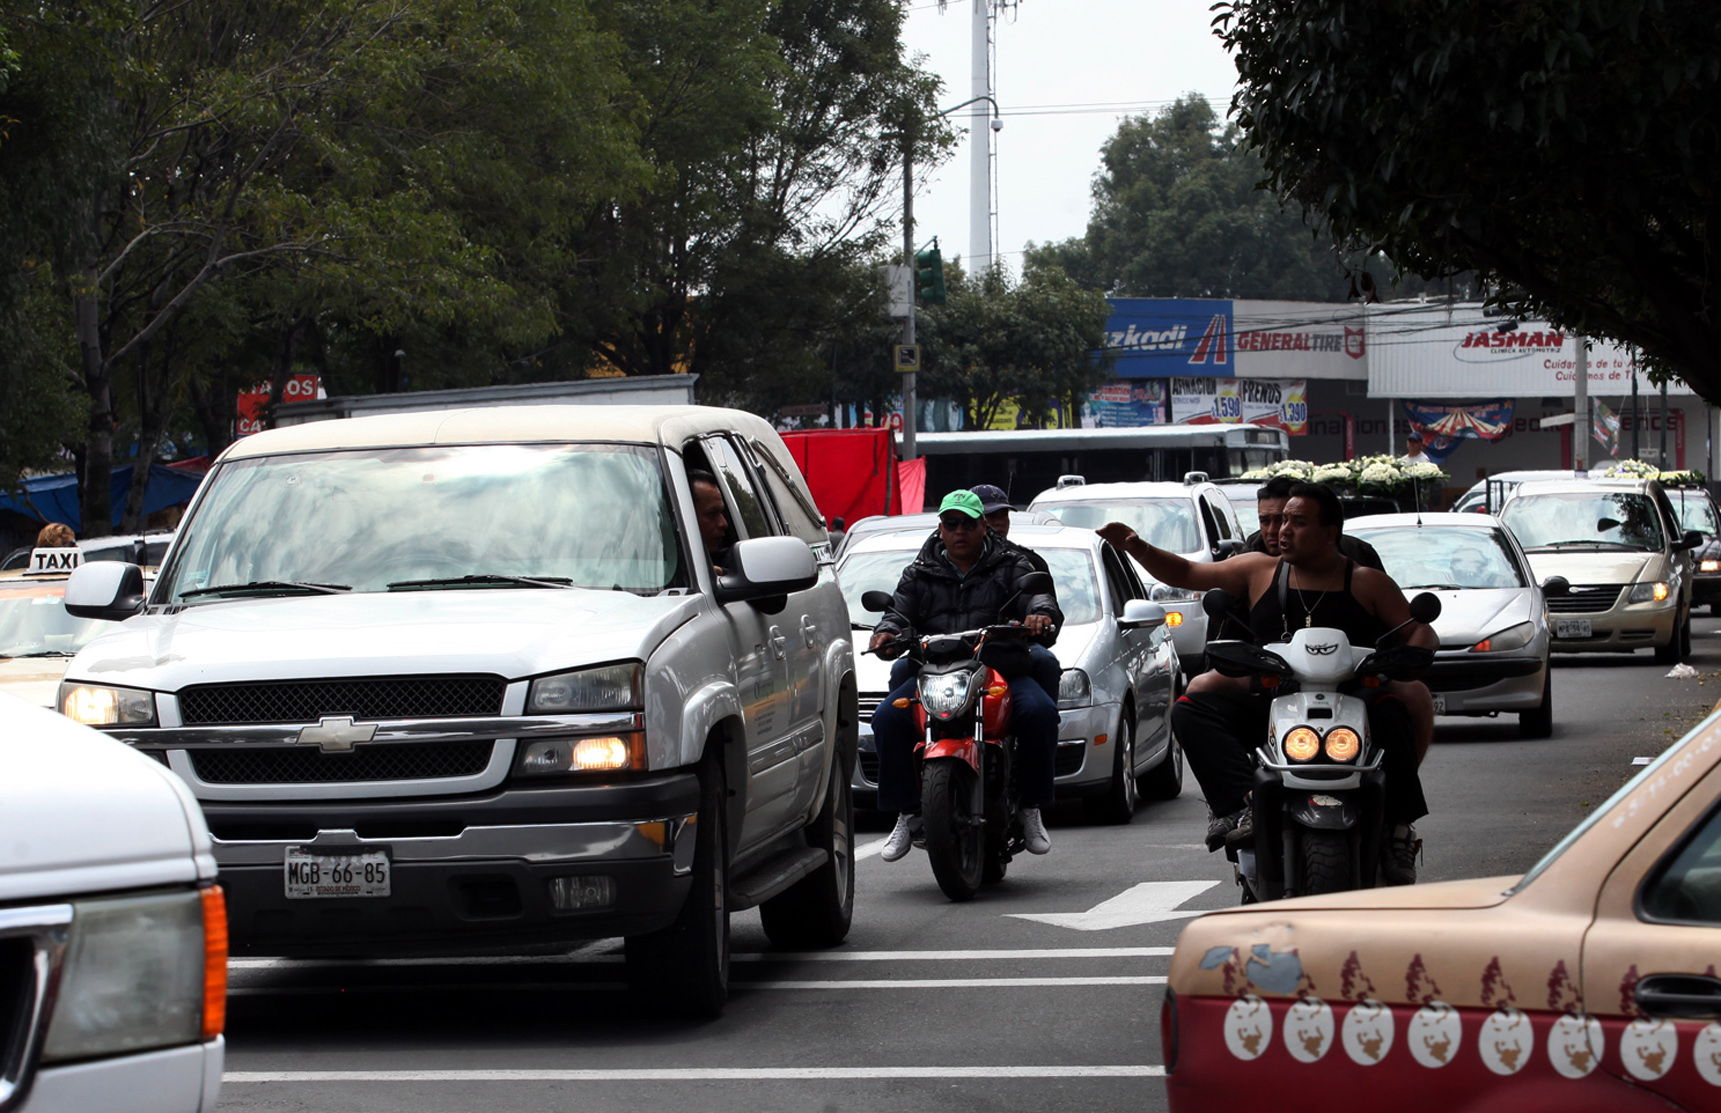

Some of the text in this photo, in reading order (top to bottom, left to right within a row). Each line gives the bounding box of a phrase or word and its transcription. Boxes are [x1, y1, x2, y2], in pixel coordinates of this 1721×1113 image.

[1461, 331, 1566, 348] JASMAN
[1543, 359, 1593, 369] Cuidas
[1596, 359, 1608, 369] de
[1609, 370, 1621, 380] de
[1242, 380, 1282, 404] FRENOS
[35, 553, 78, 570] TAXI
[288, 862, 386, 885] MGB-66-85
